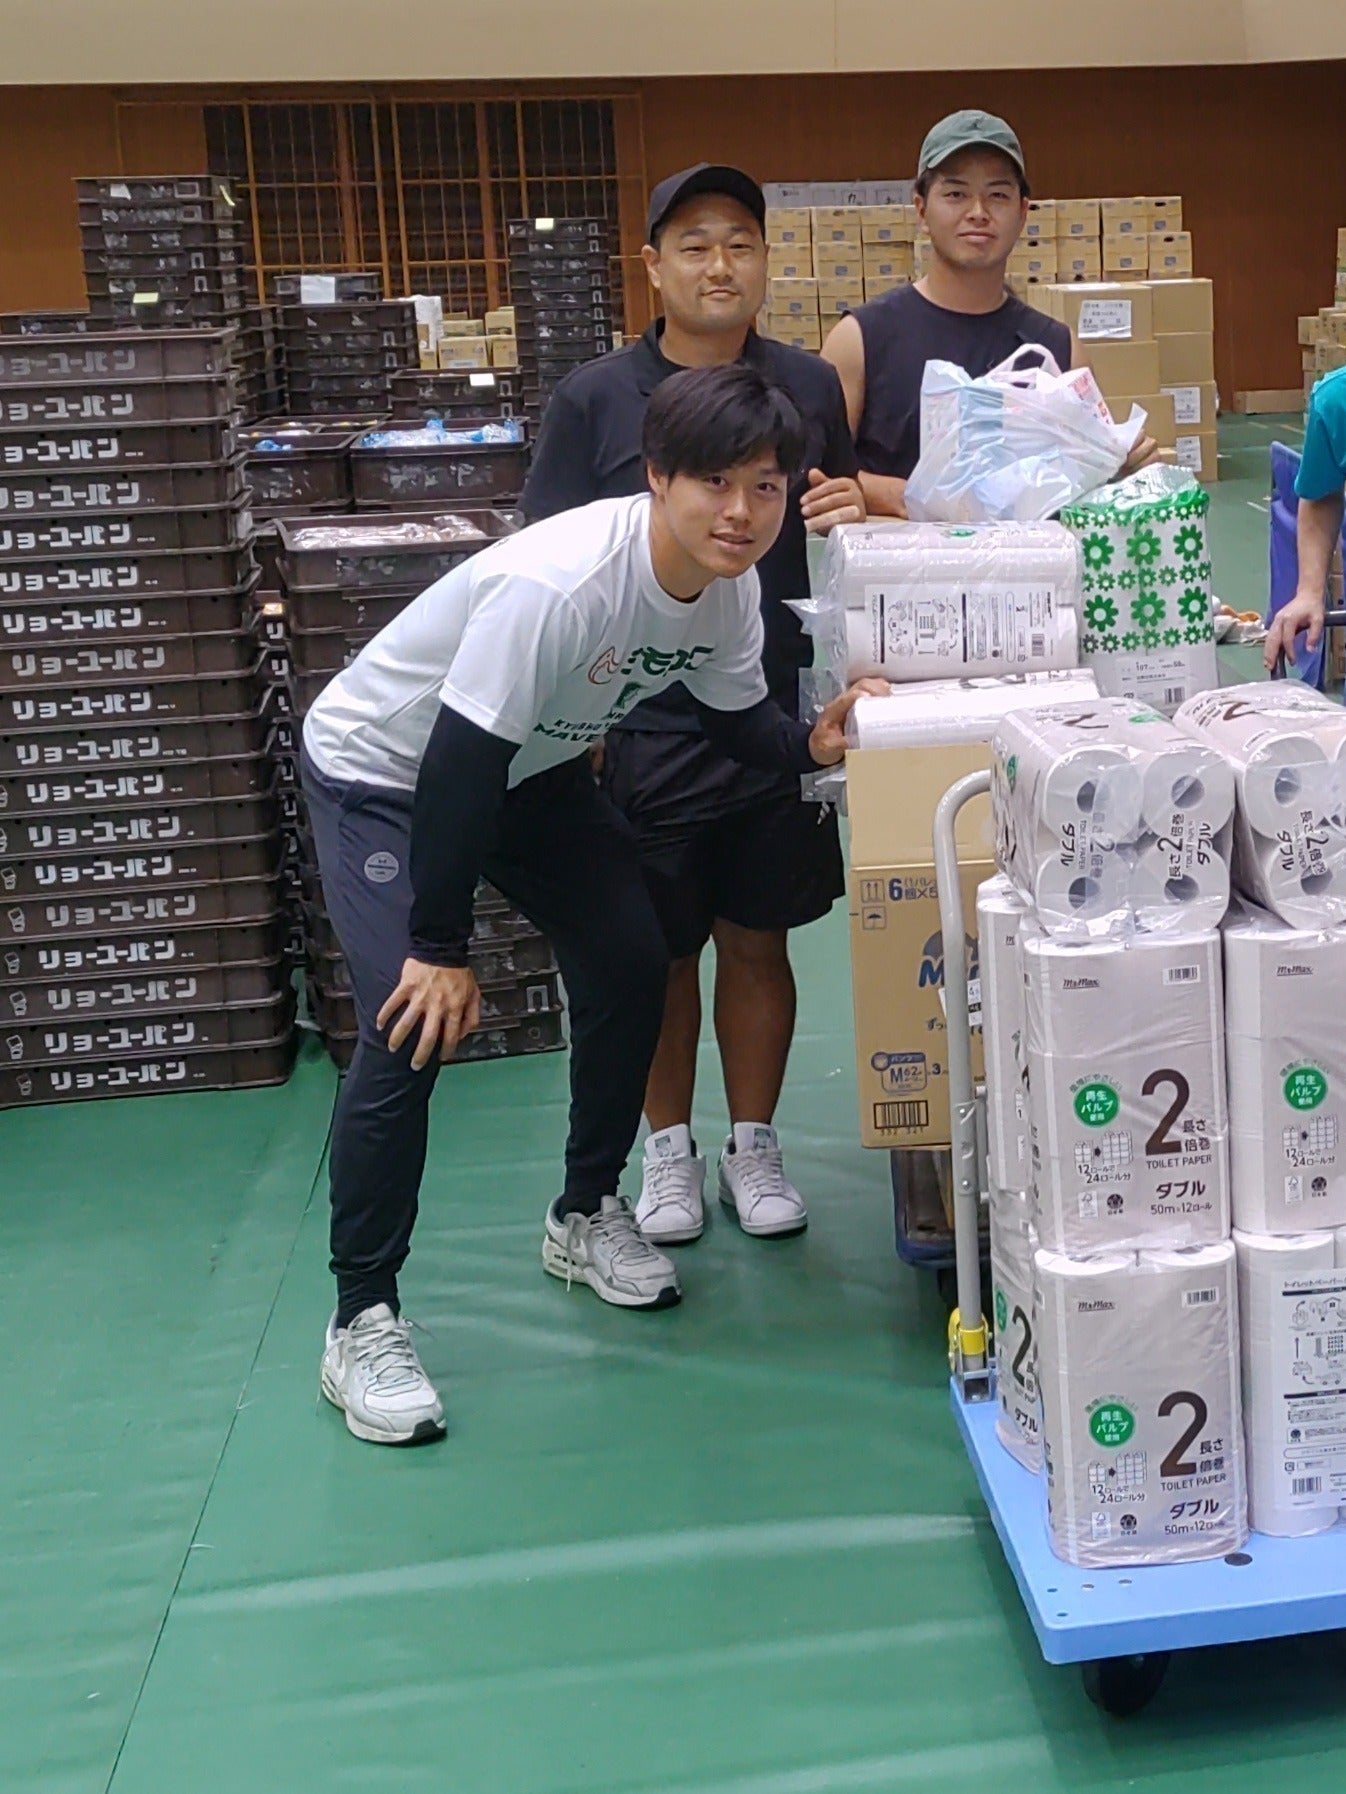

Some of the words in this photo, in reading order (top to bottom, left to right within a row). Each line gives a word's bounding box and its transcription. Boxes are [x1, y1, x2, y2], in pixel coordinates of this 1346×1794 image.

[0, 350, 136, 376] ョーユーパン
[0, 394, 134, 421] ョーユーパン
[0, 566, 138, 592] リョーユーパン
[3, 608, 142, 634] リョーユーパン
[12, 647, 165, 677] リョーユーパン
[12, 692, 152, 720] リョーユーパン
[16, 737, 159, 765] リョーユーパン
[27, 774, 164, 803] リョーユーパン
[28, 816, 181, 848] リョーユーパン
[1060, 823, 1076, 866] ダブル
[35, 856, 173, 885] リョーユーパン
[46, 895, 196, 927] リョーユーパン
[38, 940, 175, 969] リョーユーパン
[48, 978, 197, 1010] リョーユーパン
[44, 1022, 195, 1054] リョーユーパン
[51, 1061, 186, 1090] リョーユーパン
[1142, 1069, 1190, 1156] 2
[1146, 1158, 1180, 1170] TOILET
[1182, 1155, 1212, 1166] PAPER
[1156, 1180, 1206, 1200] ダブル
[1158, 1391, 1207, 1477] 2
[1161, 1480, 1194, 1491] TOILET
[1196, 1473, 1226, 1487] PAPER
[1170, 1499, 1219, 1519] ダブル
